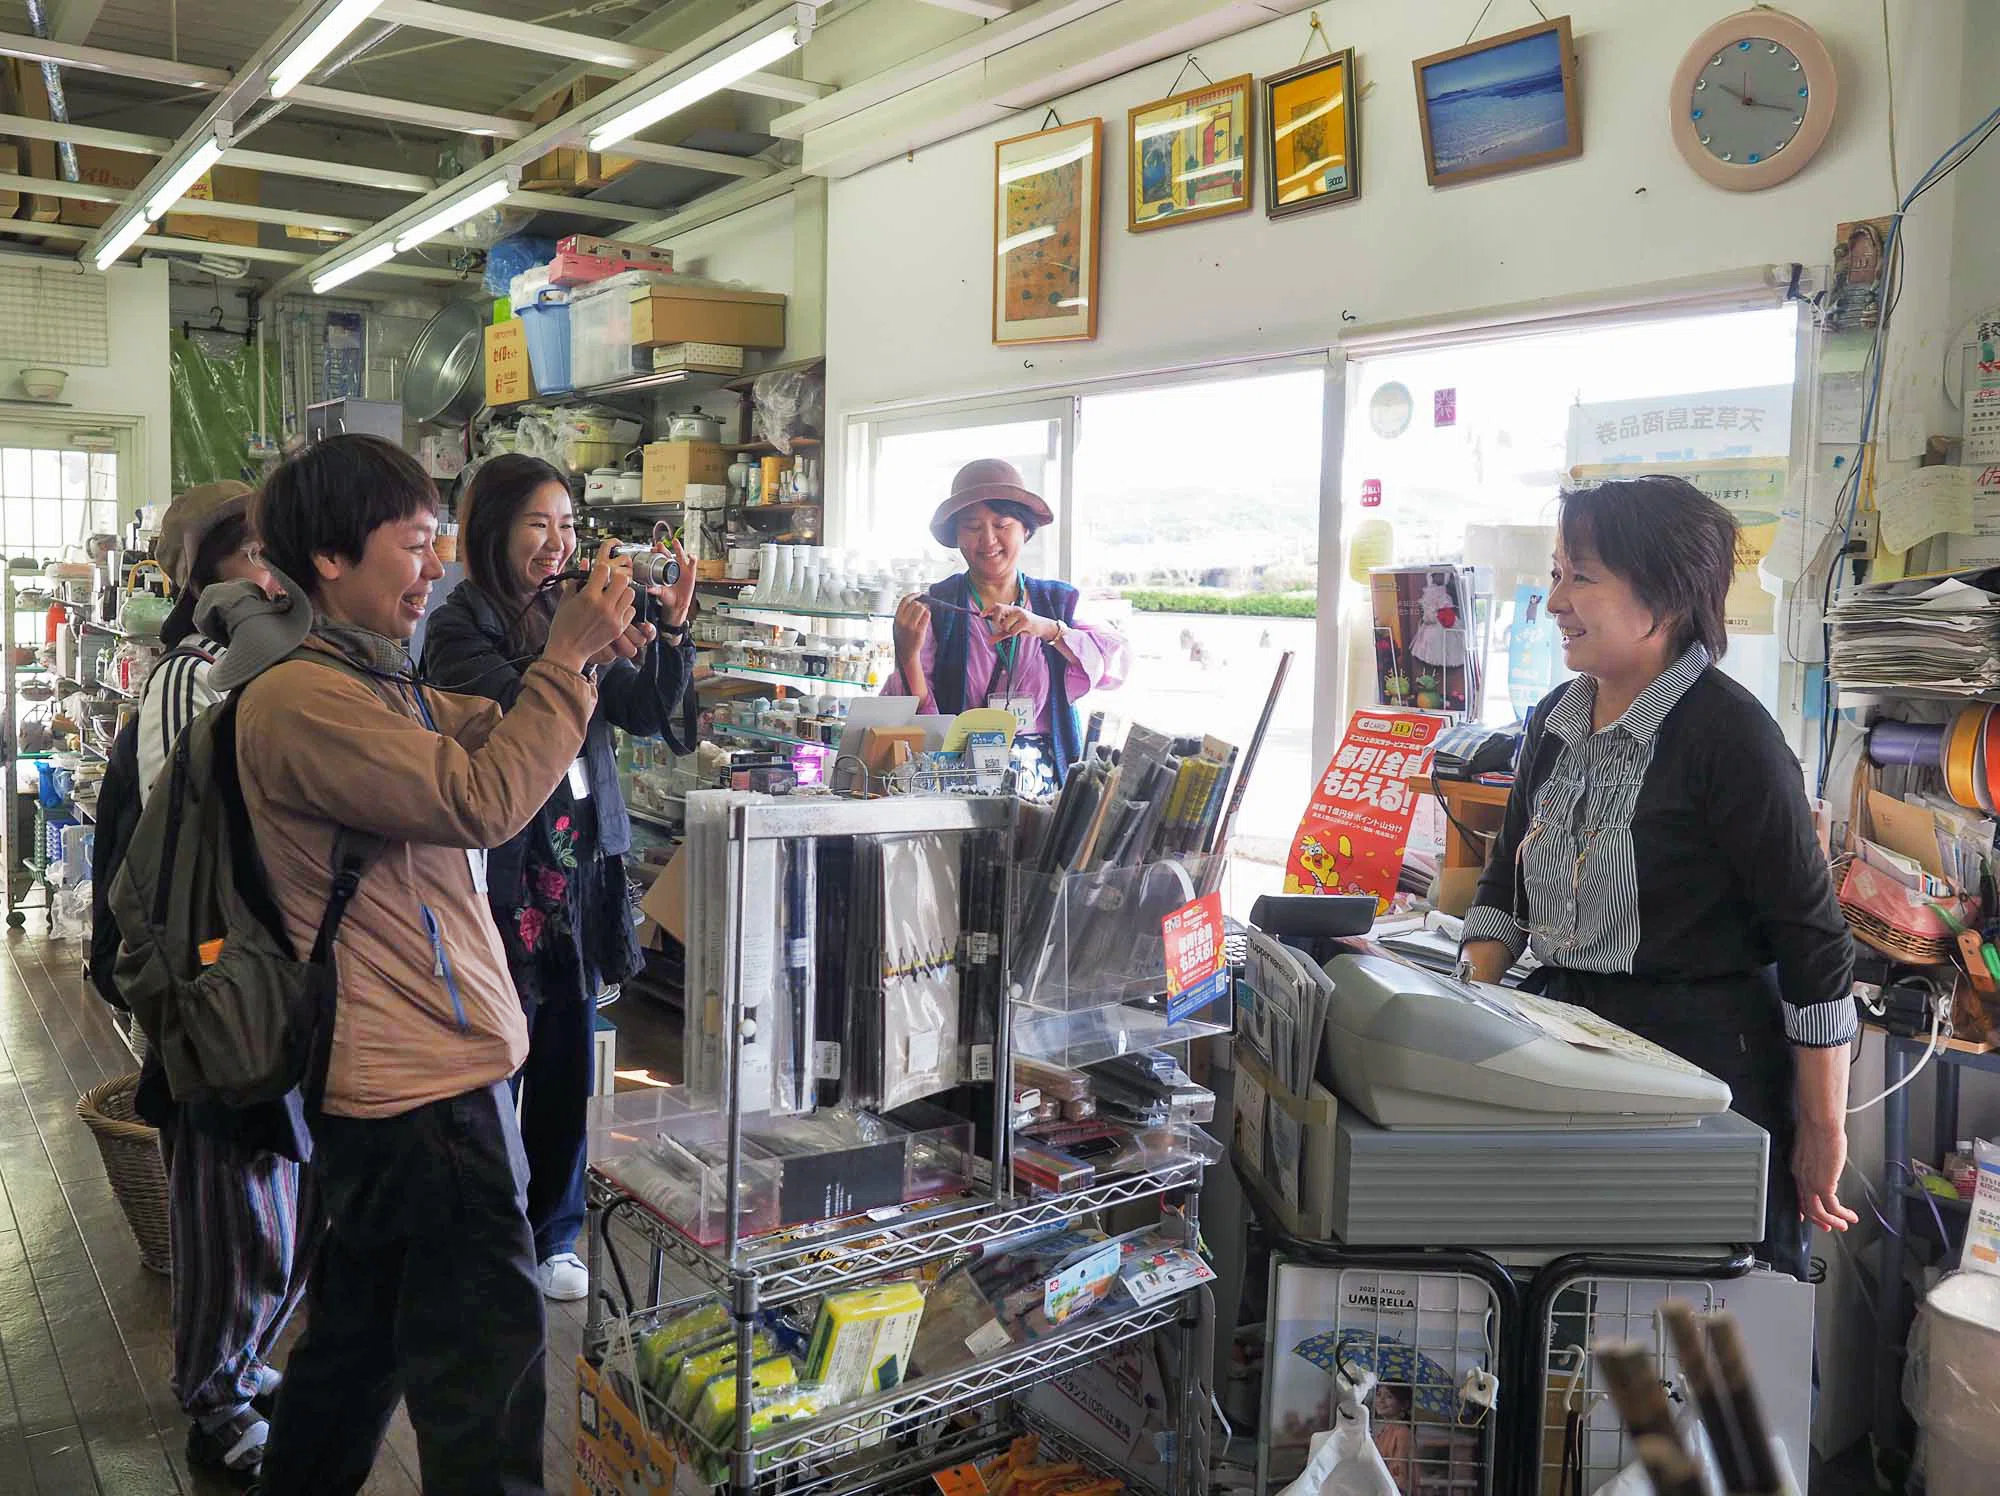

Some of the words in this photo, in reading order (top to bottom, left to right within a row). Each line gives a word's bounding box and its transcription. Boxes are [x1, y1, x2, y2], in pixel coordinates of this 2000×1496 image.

[1328, 176, 1343, 187] 3000
[1323, 770, 1414, 816] もらえる!
[1359, 1285, 1376, 1293] 2023
[1348, 1294, 1414, 1307] UMBRELLA
